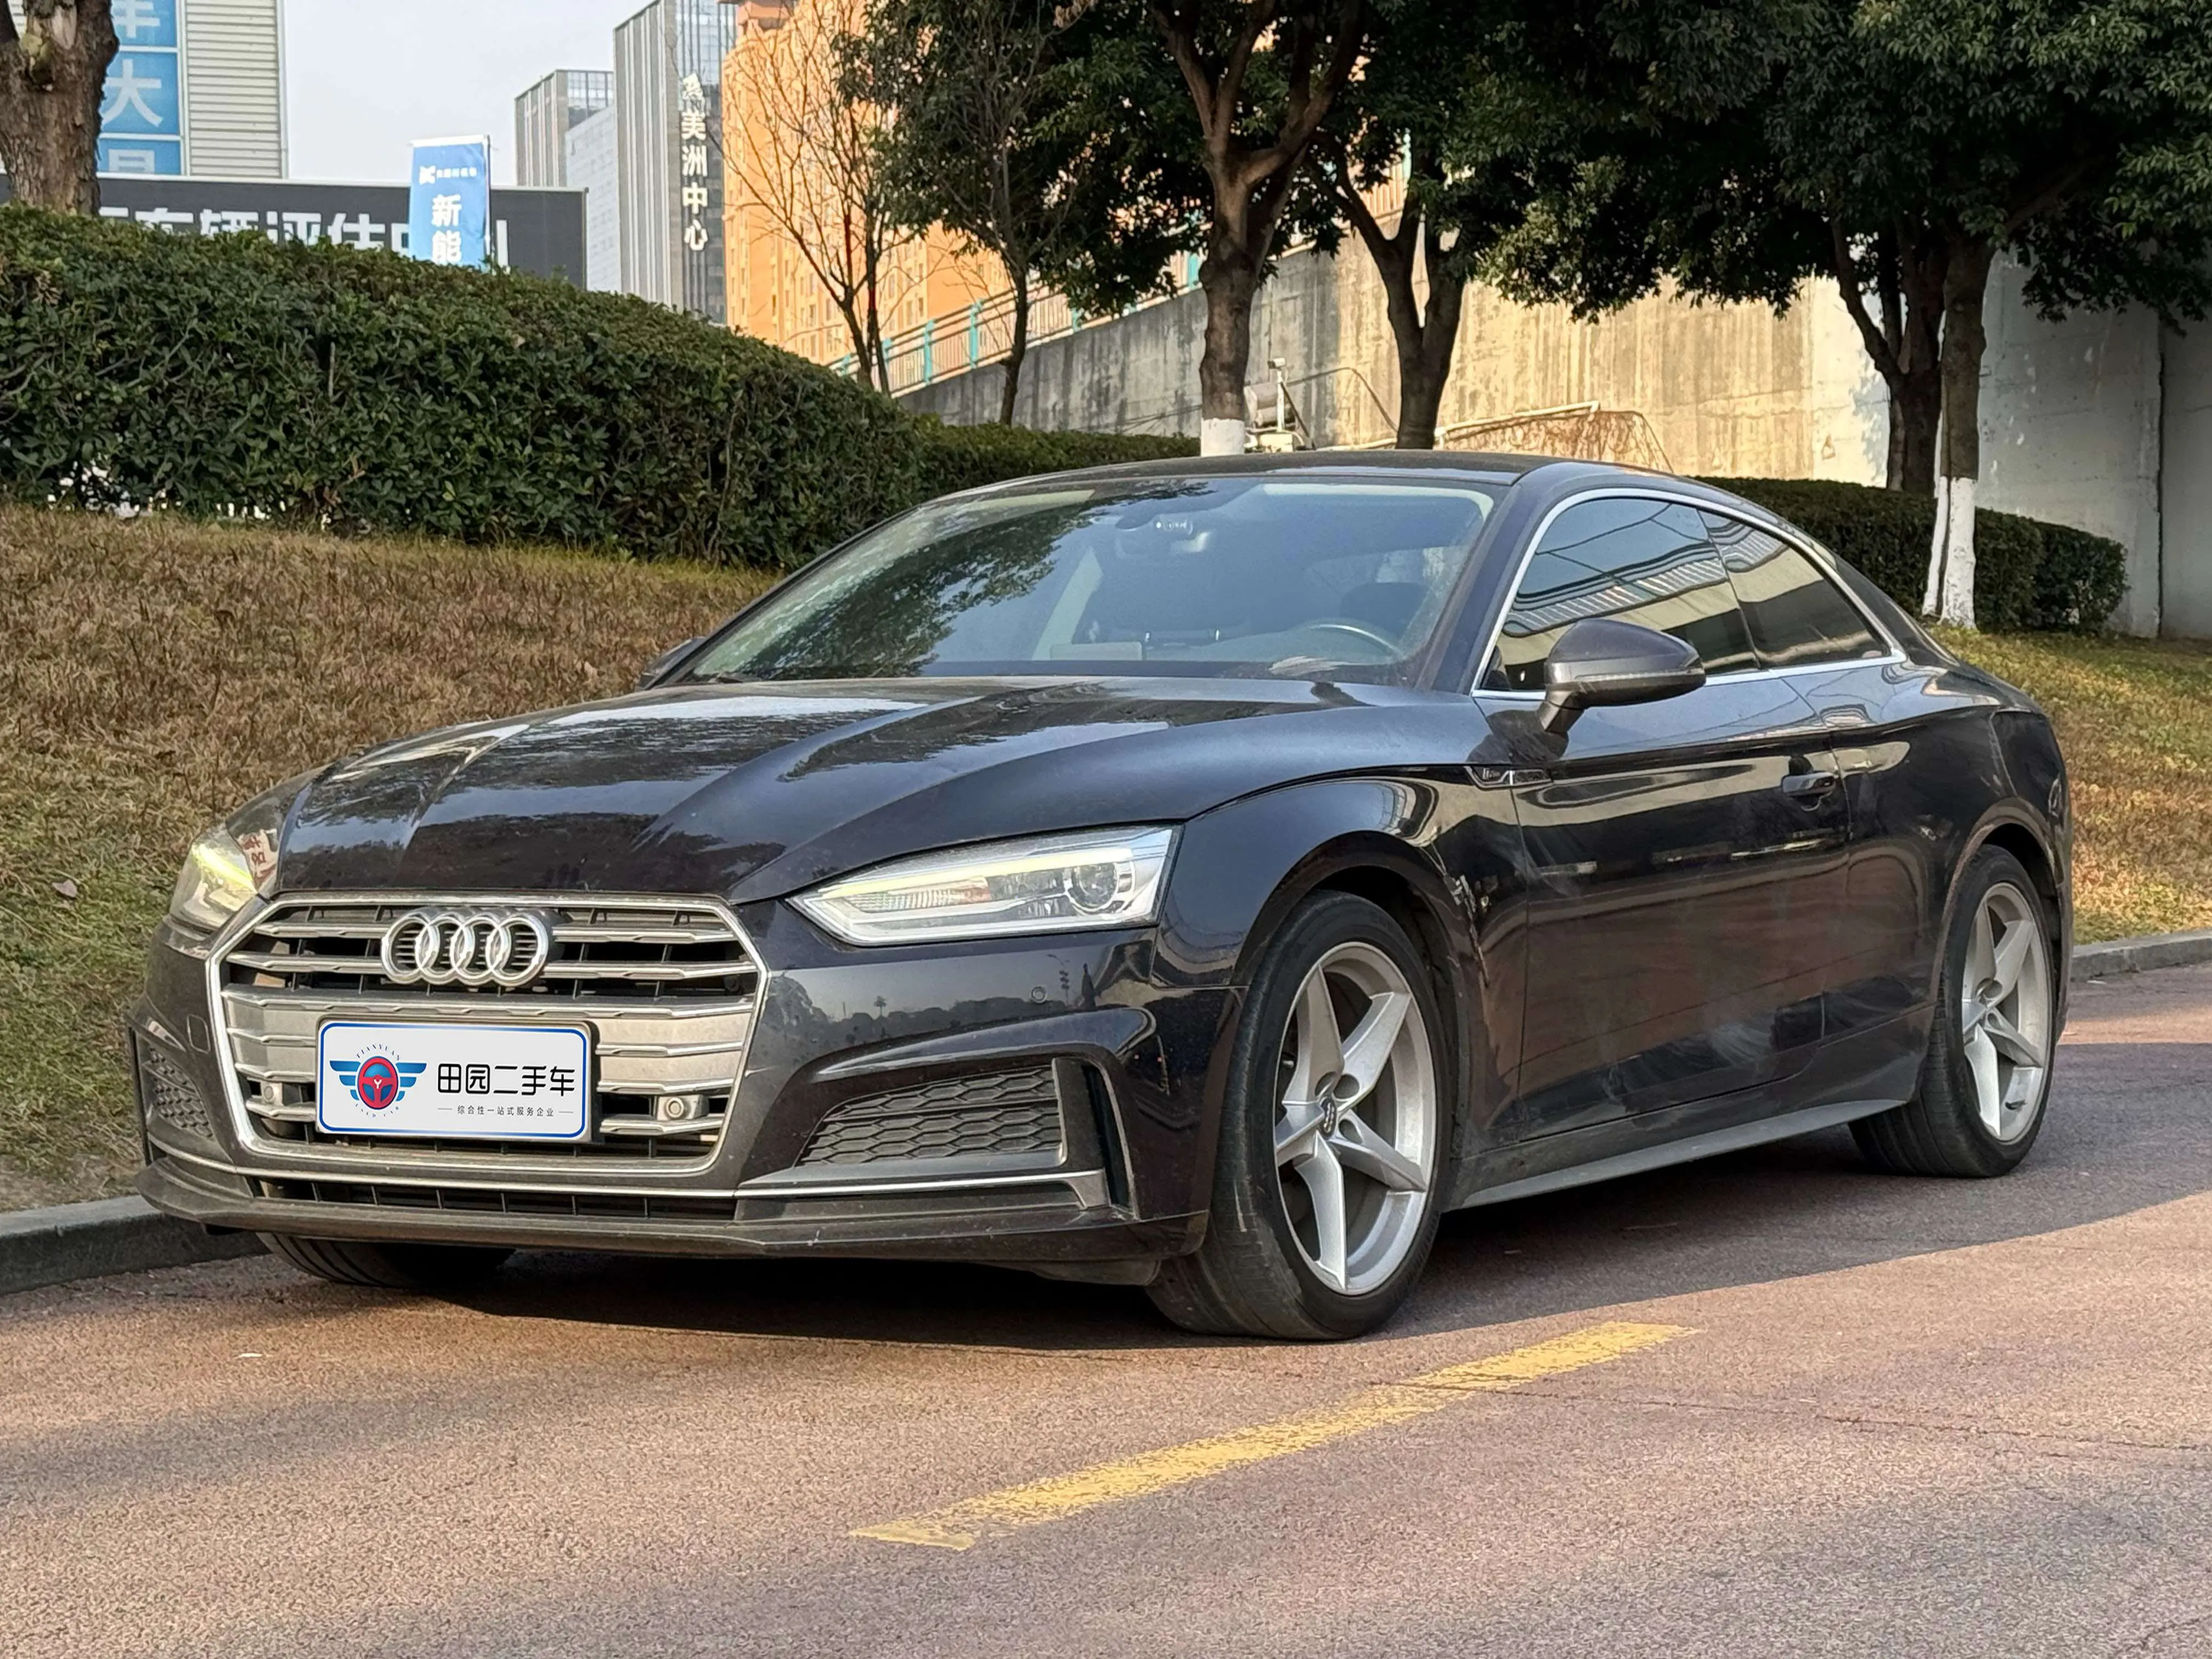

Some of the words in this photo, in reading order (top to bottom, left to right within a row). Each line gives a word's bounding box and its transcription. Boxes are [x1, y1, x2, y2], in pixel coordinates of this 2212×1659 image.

[438, 1063, 575, 1097] 田园二手车
[457, 1105, 554, 1117] 综合性一站式服务企业
